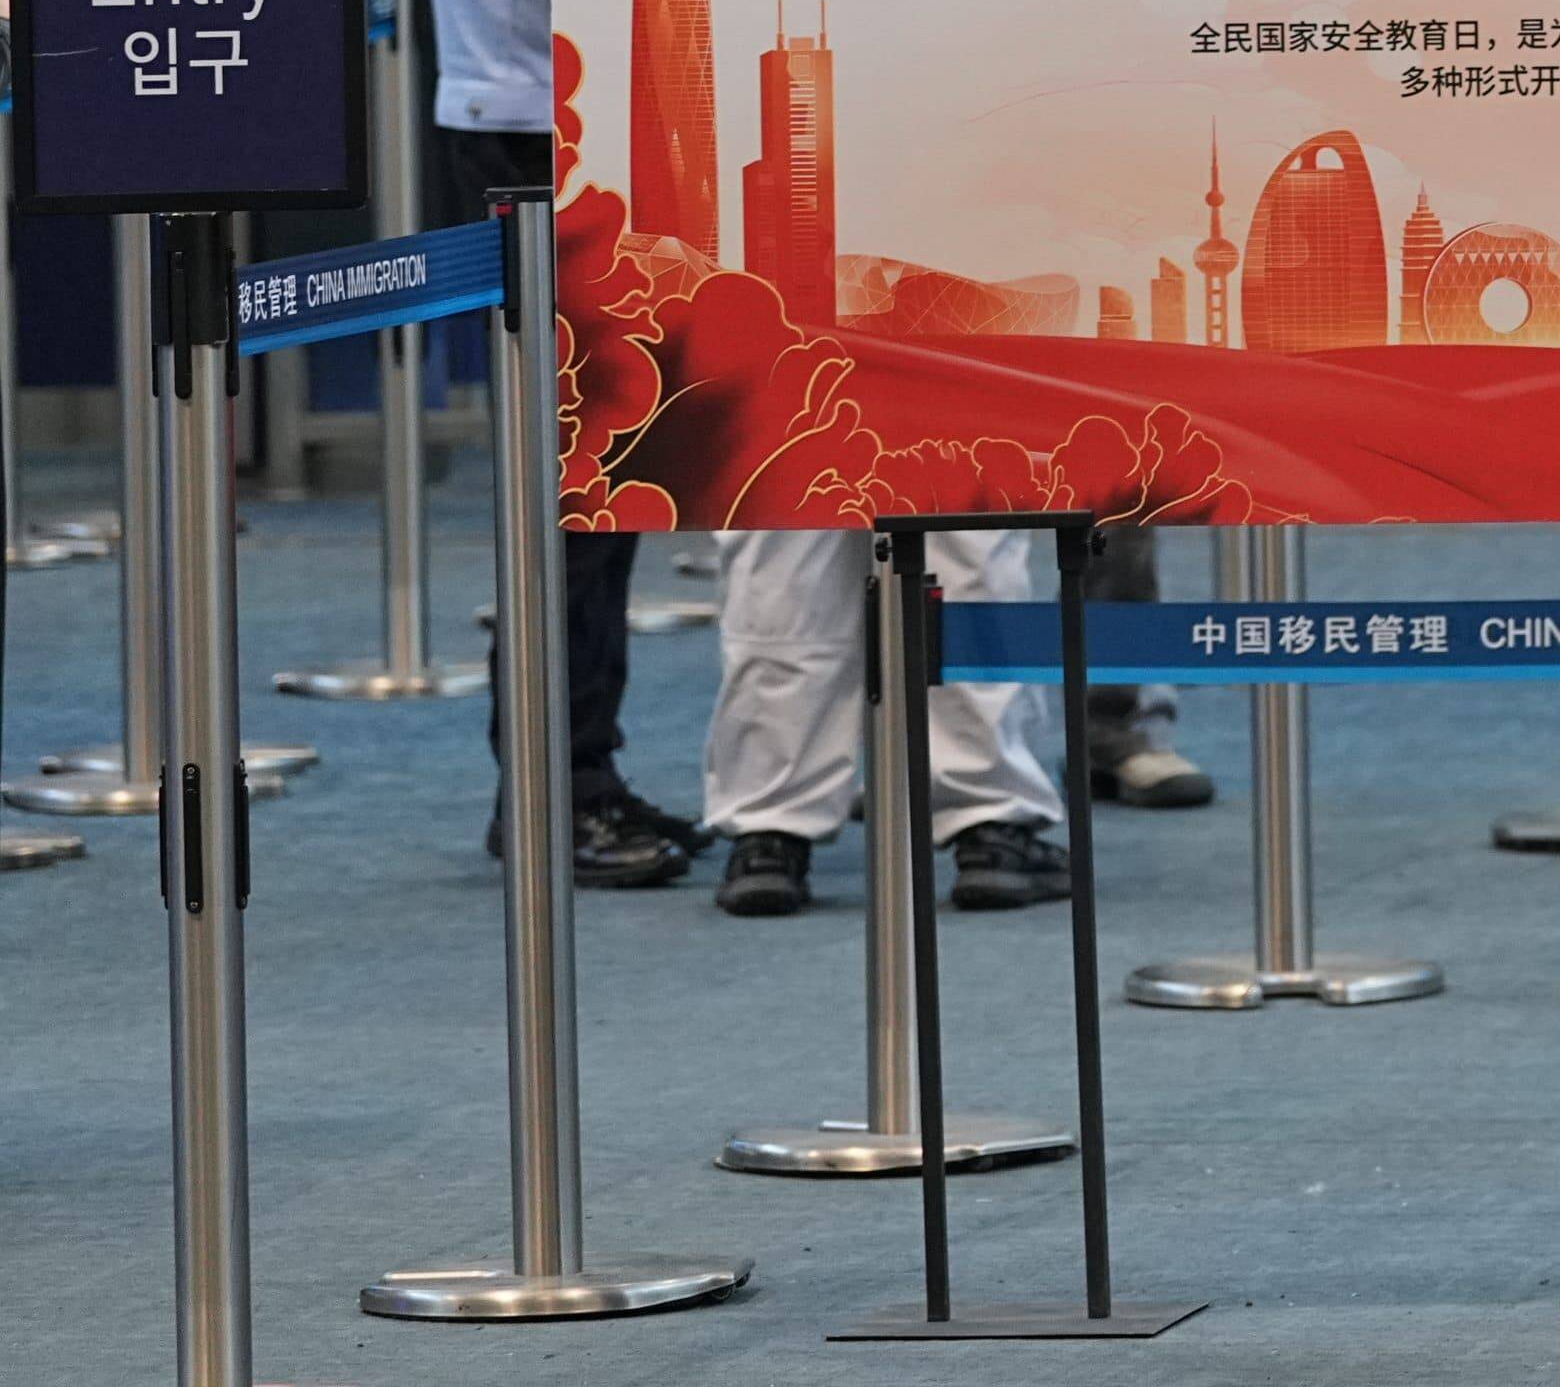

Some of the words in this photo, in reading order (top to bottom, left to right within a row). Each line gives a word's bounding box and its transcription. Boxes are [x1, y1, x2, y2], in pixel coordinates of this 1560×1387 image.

[124, 27, 249, 96] 입구
[238, 274, 298, 324] 移民管理
[307, 270, 346, 308] CHINA
[347, 253, 426, 299] IMMIGRATION
[1192, 613, 1449, 656] 中国移民管理
